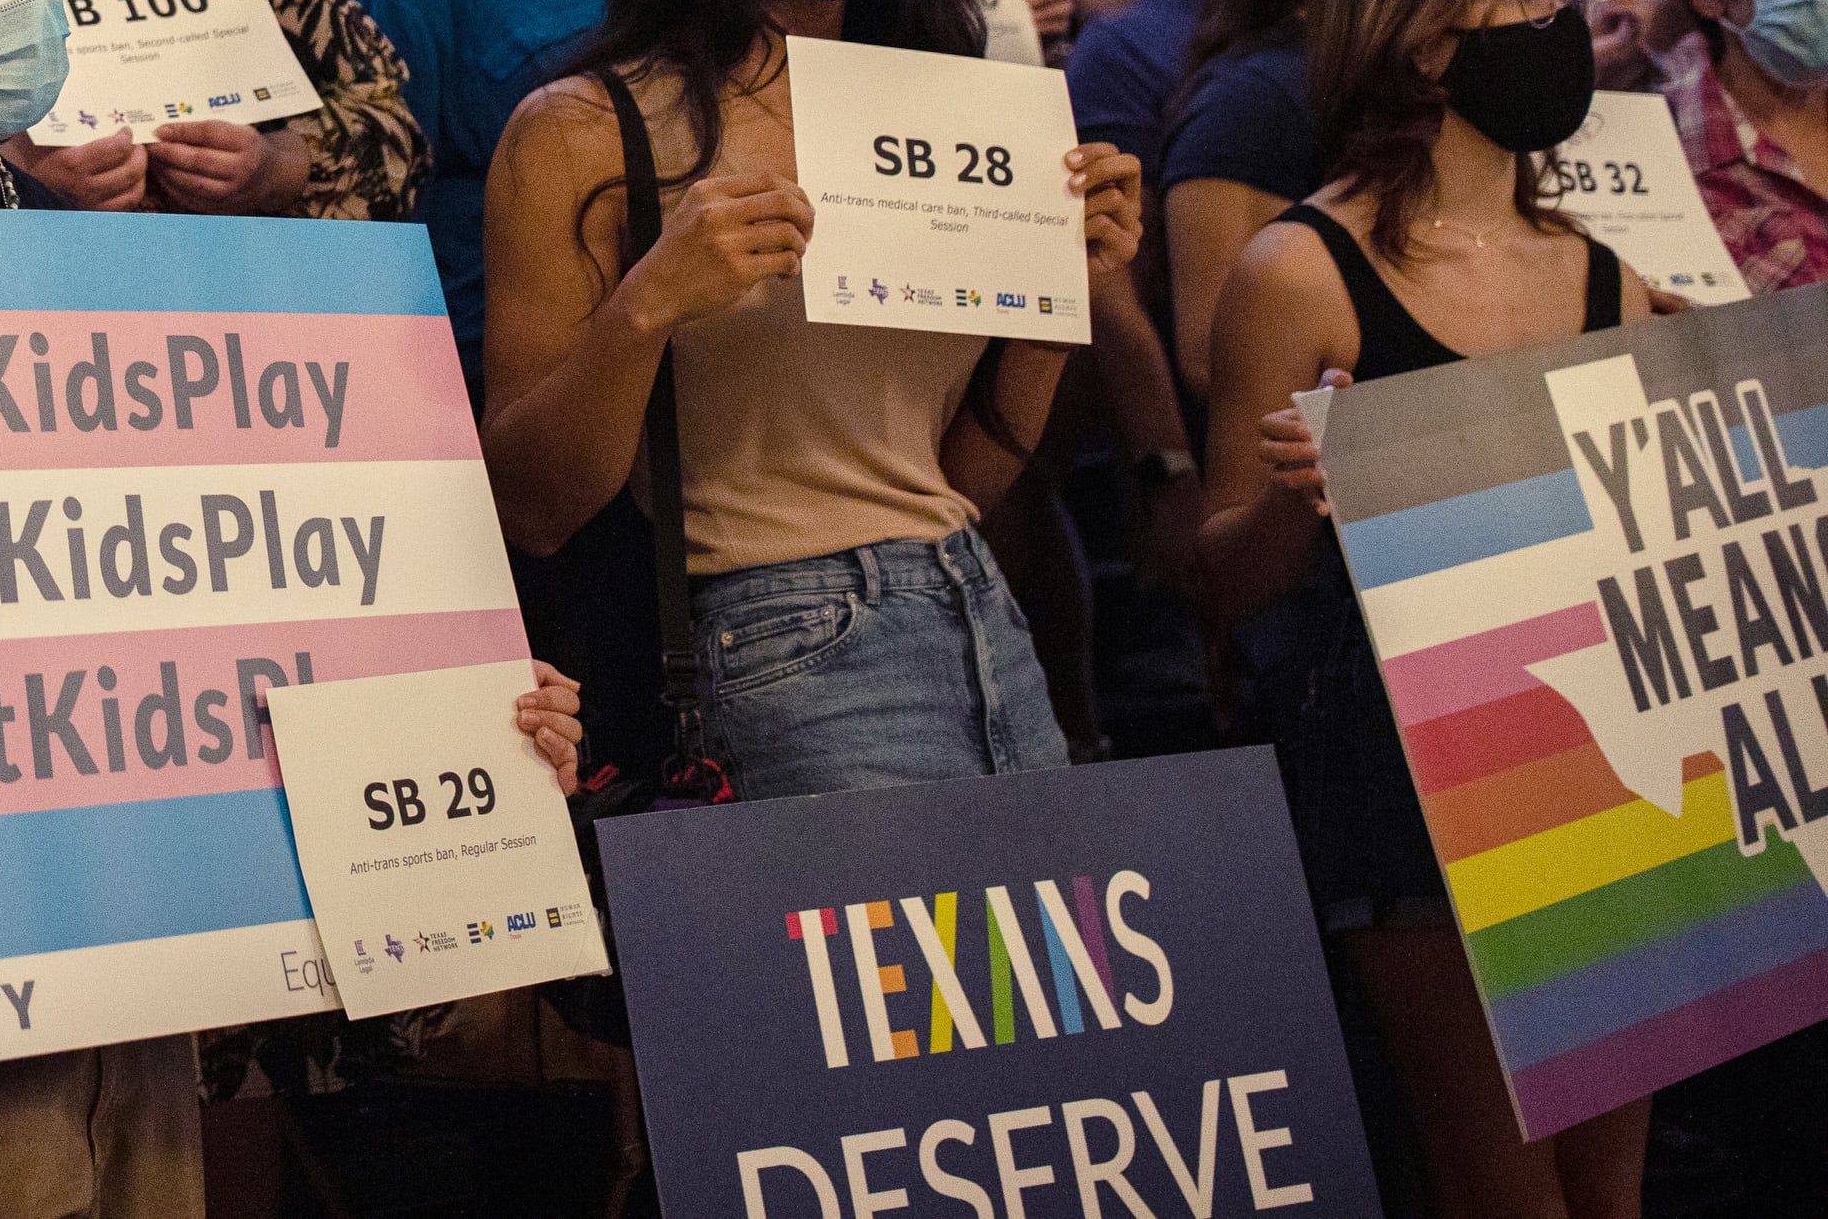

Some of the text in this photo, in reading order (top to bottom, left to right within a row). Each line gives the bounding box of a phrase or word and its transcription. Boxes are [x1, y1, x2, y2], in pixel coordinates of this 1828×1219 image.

[873, 135, 1014, 186] SB 28
[1557, 159, 1649, 195] SB 32
[820, 192, 1069, 226] Anti-trans medical care ban, Third-called Special
[930, 219, 969, 233] Session
[996, 292, 1025, 308] ACLU
[1572, 388, 1819, 554] Y'ALL
[1597, 514, 1828, 714] MEAN
[364, 767, 496, 831] SB 29
[350, 835, 537, 875] Anti-trans sports ban, Regular Session
[430, 931, 447, 939] TEXAS
[507, 911, 536, 932] ACLU
[431, 937, 456, 946] FREEDOM
[433, 943, 459, 952] NETWORK
[784, 869, 1175, 1070] TEXANS
